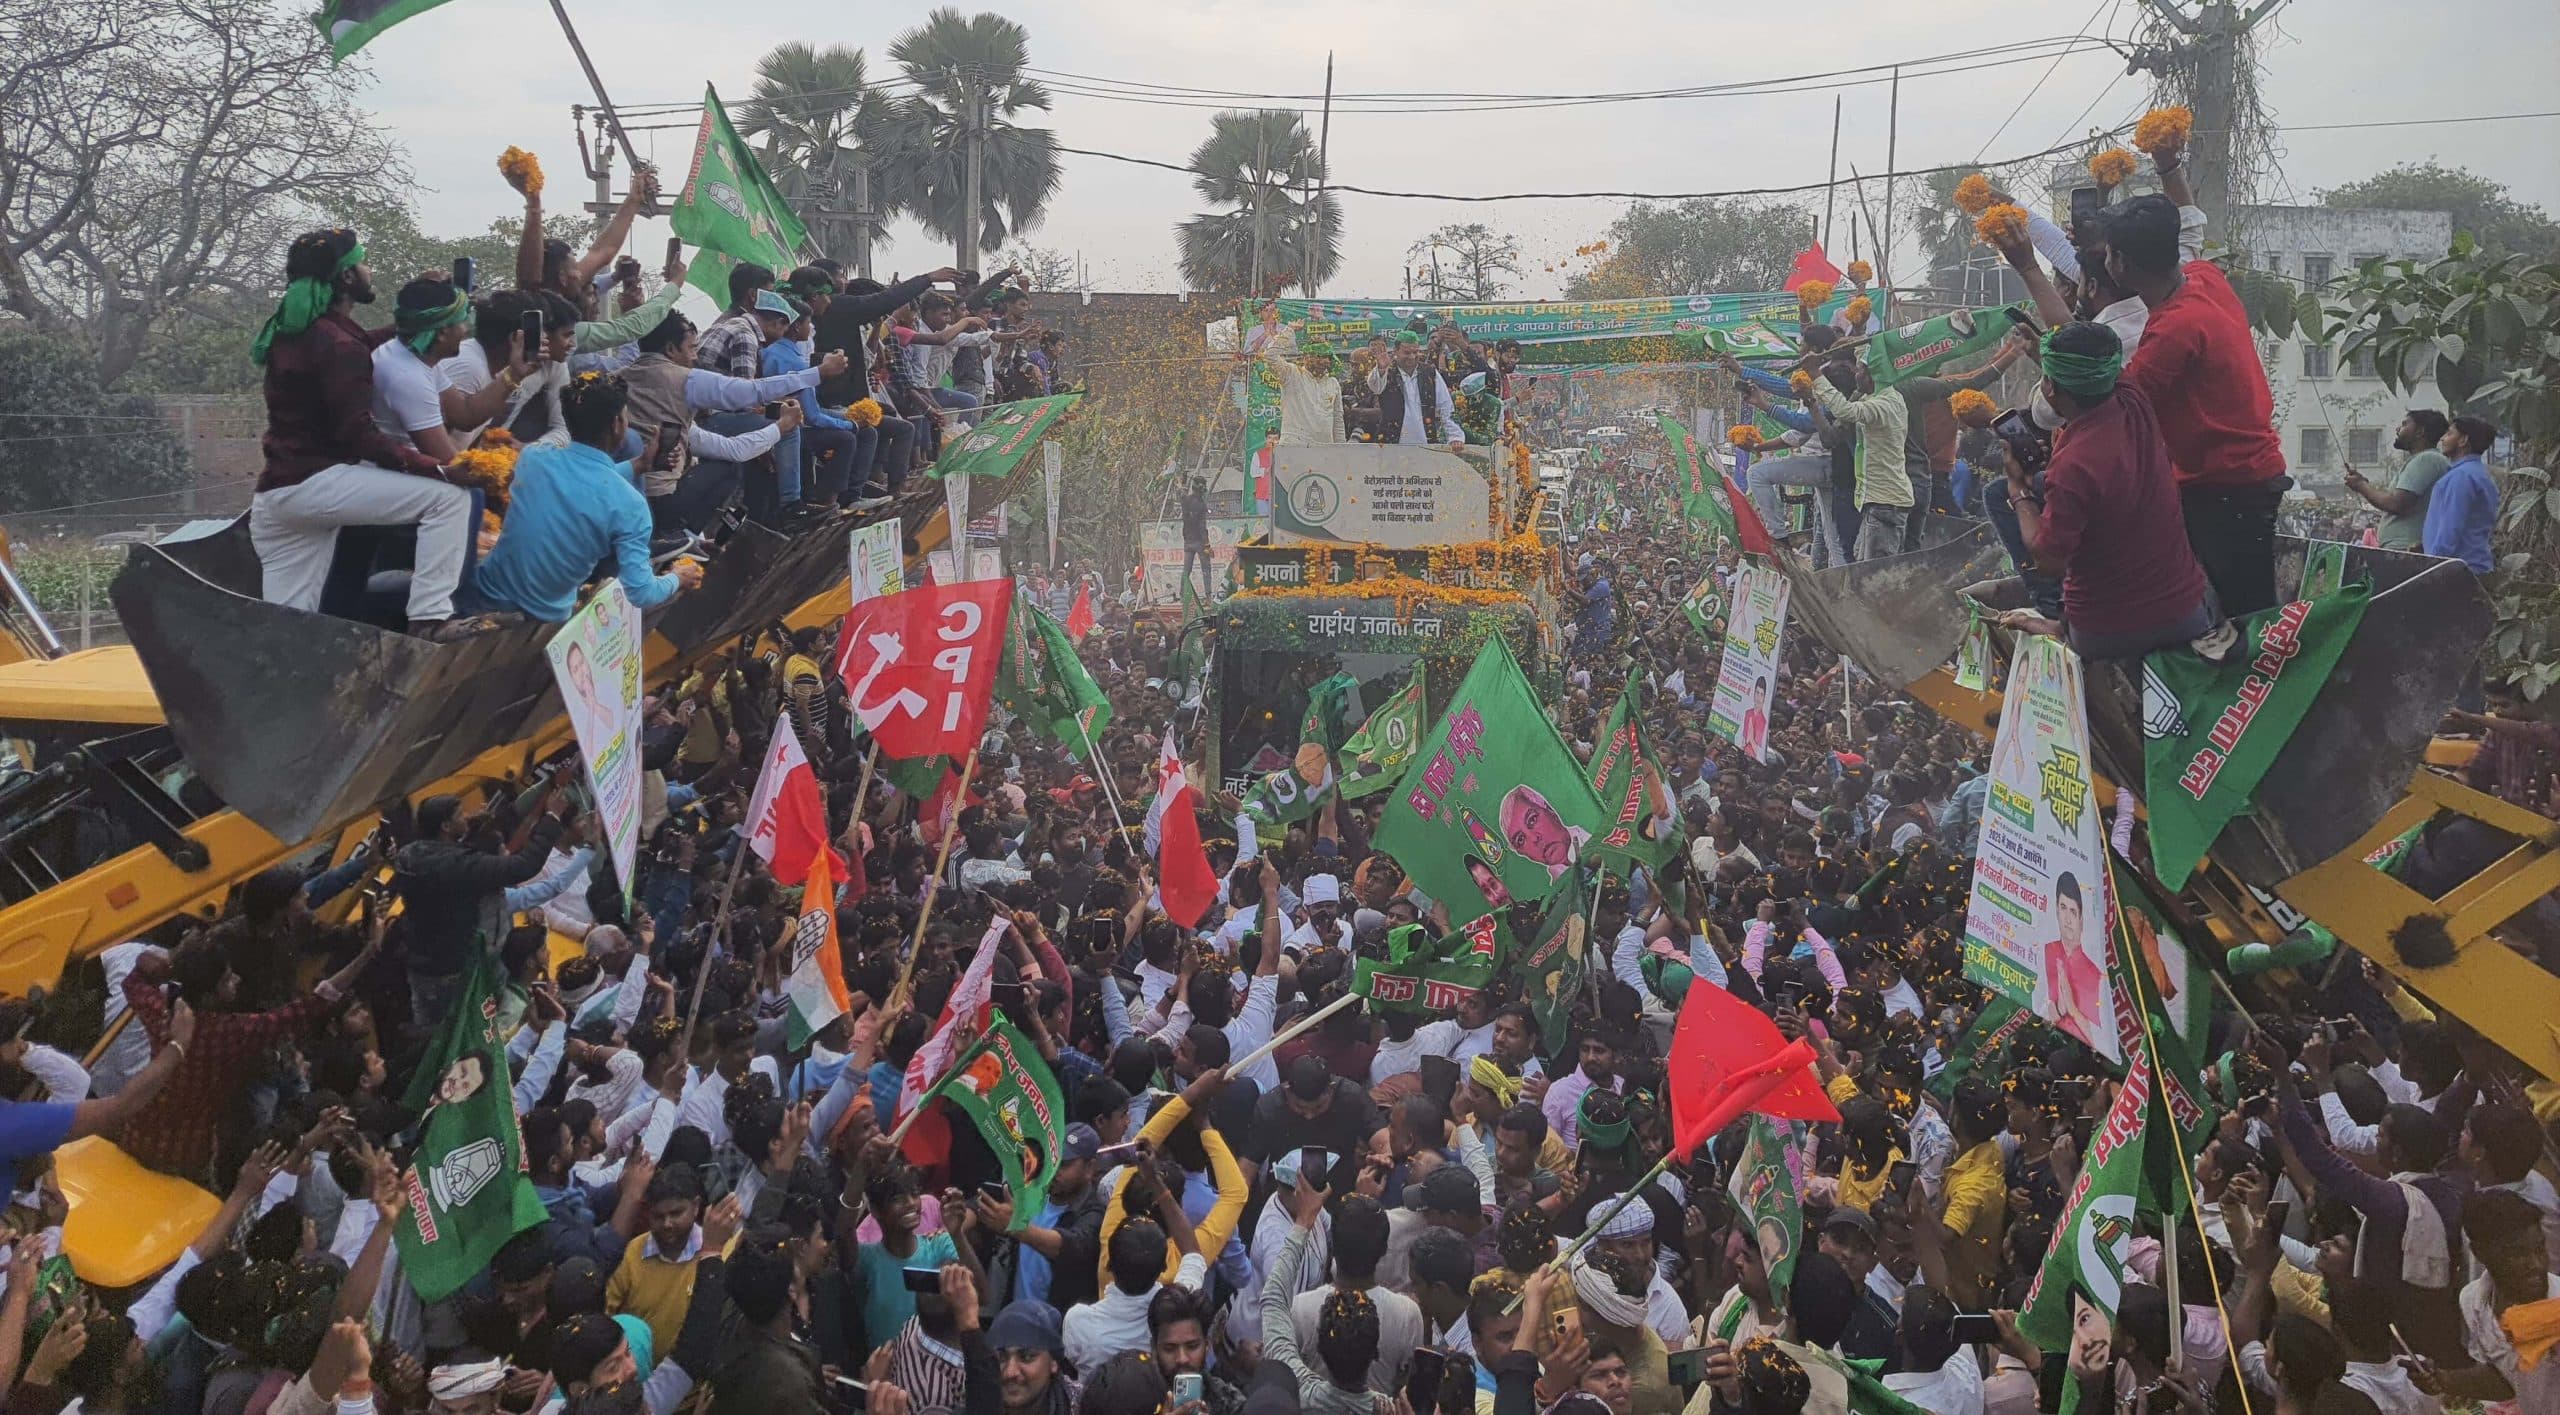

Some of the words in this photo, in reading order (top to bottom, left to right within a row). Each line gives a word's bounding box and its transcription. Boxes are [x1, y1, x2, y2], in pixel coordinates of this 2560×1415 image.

[1494, 323, 1509, 333] पर
[1514, 321, 1553, 332] आपका
[1372, 488, 1384, 497] नई
[1423, 488, 1432, 497] को
[1397, 476, 1404, 485] के
[1434, 475, 1442, 485] से
[1371, 499, 1389, 509] आओ
[1405, 501, 1420, 510] साथ
[1372, 513, 1386, 522] नया
[1387, 512, 1406, 522] बिहार
[1424, 512, 1434, 522] को
[1256, 560, 1301, 582] अपनी
[1307, 610, 1358, 638] राष्ट्रीय
[1359, 616, 1408, 636] जनता
[1413, 618, 1442, 638] दल
[2207, 675, 2274, 755] जनता
[2055, 748, 2080, 776] जन
[2179, 746, 2226, 801] दल
[1224, 774, 1249, 798] नई
[2043, 766, 2086, 805] विश्वास
[2051, 798, 2080, 831] यात्रा
[1976, 856, 1984, 875] श्री
[2002, 875, 2020, 897] प्रसाद
[2020, 885, 2039, 908] यादव
[2038, 895, 2048, 913] जी
[1966, 941, 1997, 973] संजीत
[1999, 958, 2034, 994] कुमार
[1016, 1067, 1052, 1130] जनता
[2164, 1067, 2204, 1133] दल
[416, 1212, 440, 1246] छाप
